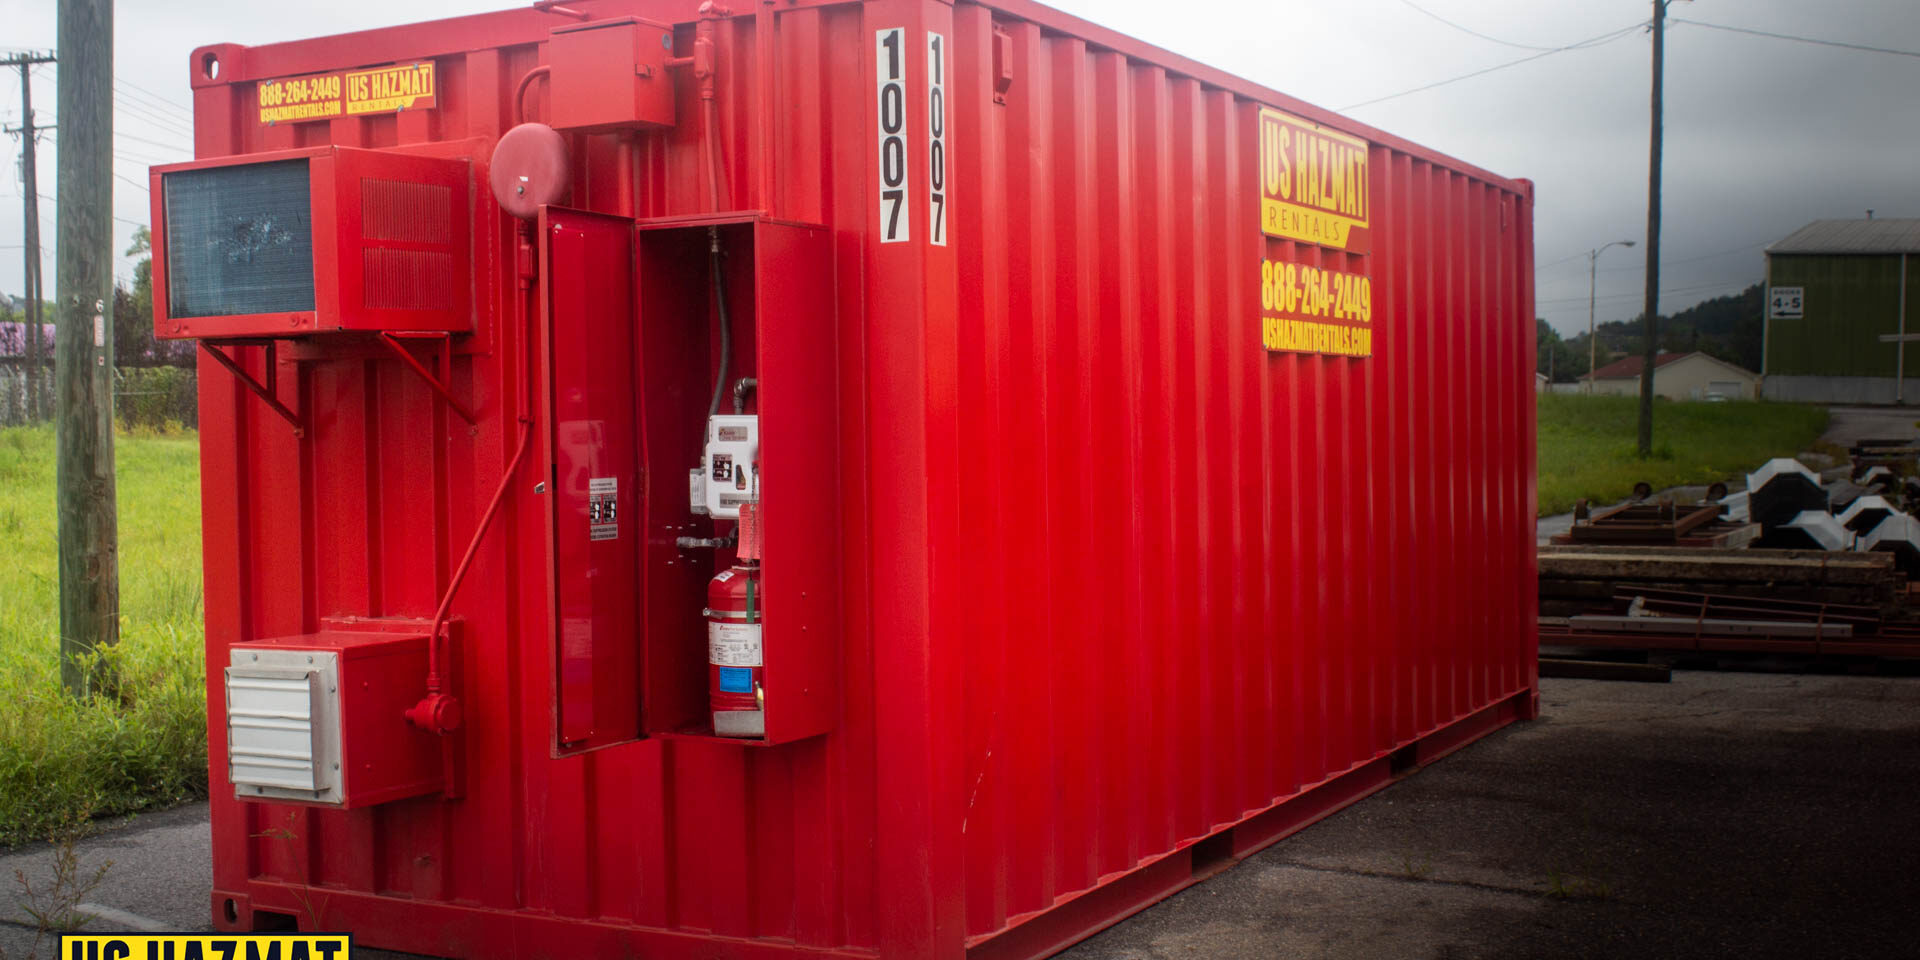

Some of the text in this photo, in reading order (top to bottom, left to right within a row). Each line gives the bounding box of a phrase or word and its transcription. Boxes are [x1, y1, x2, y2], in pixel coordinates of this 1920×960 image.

[260, 76, 341, 107] 888-264-2449
[350, 68, 429, 101] US HAZMAT
[260, 101, 341, 123] USHAZMATRENTALS.COM
[352, 98, 406, 112] RENTALS
[881, 30, 904, 240] 1007
[931, 36, 944, 243] 1007
[1265, 120, 1366, 218] US HAZMAT
[1269, 206, 1340, 241] RENTALS
[1262, 259, 1372, 323] 888-264-2449
[1262, 317, 1372, 357] USHAZMATRENTALS.COM
